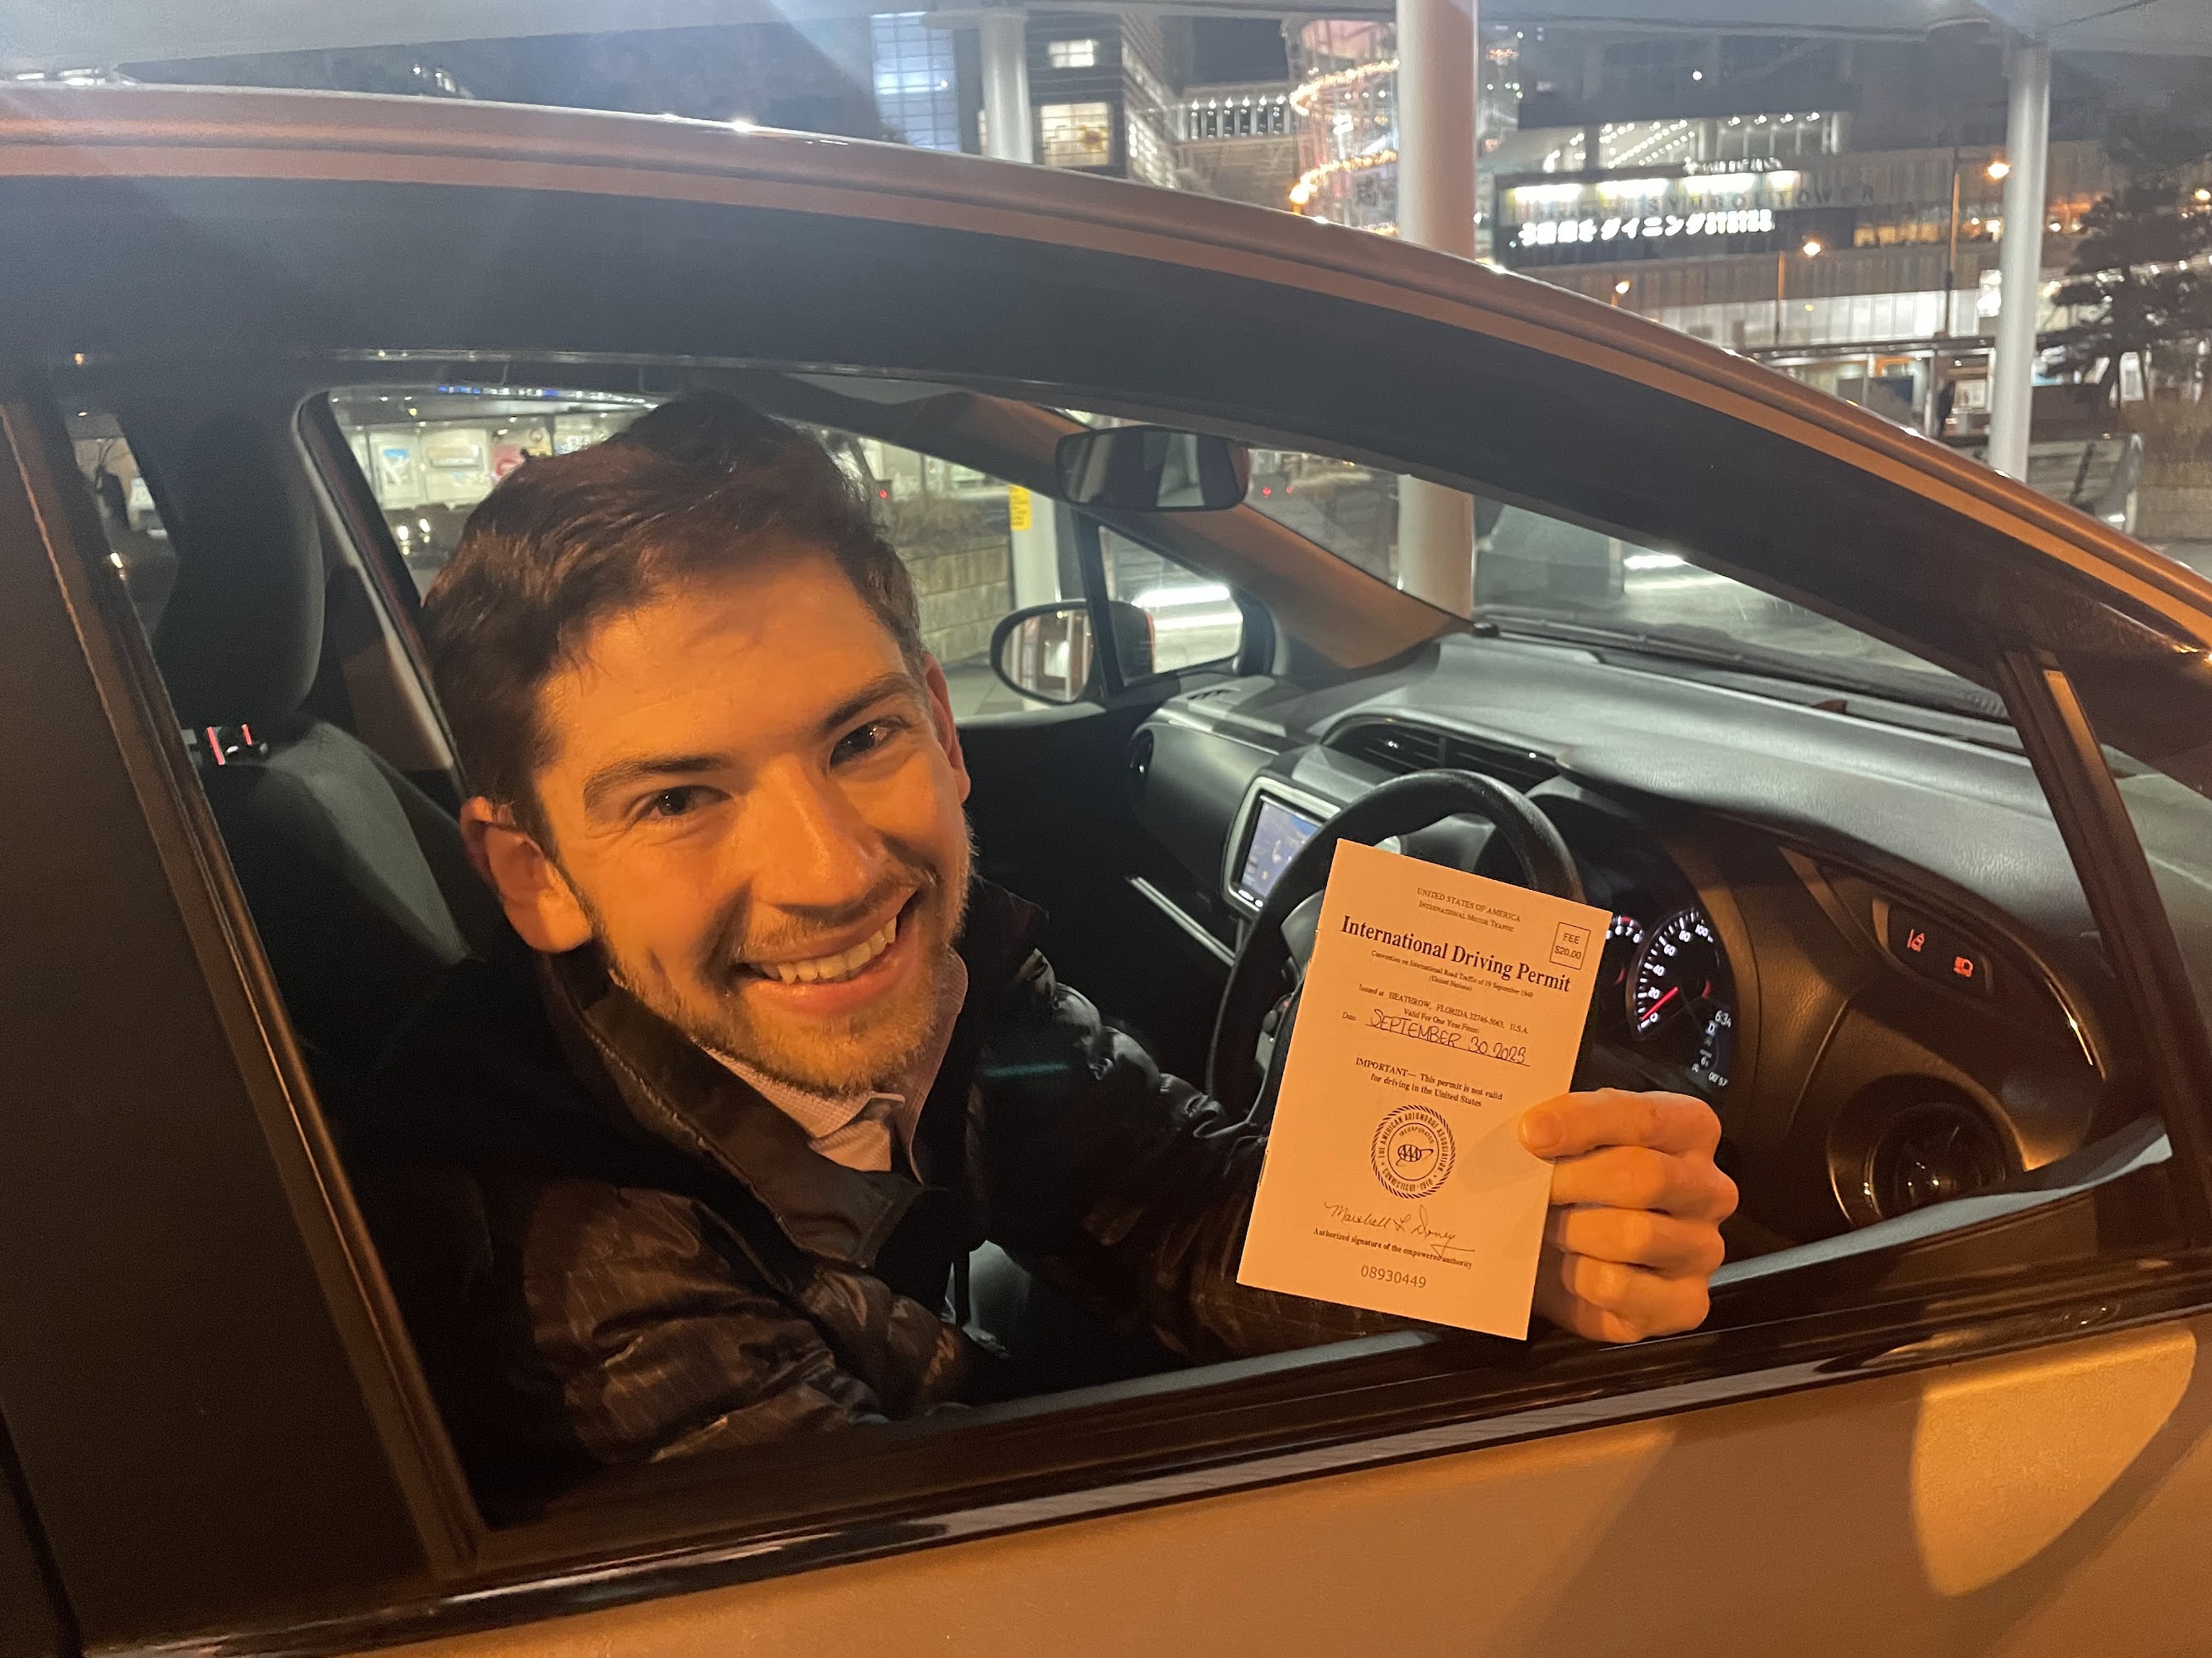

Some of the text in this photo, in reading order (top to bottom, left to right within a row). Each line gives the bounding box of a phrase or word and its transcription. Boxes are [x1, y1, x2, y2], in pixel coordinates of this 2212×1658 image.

[1417, 887, 1521, 922] UNITED STATES OF AMERICA
[1562, 932, 1580, 944] FEE
[1342, 916, 1570, 992] International Driving Permit
[1554, 945, 1582, 959] $20.00
[1371, 949, 1401, 964] Convention
[1410, 959, 1444, 974] International
[1443, 968, 1458, 978] Road
[1459, 973, 1477, 983] Traffic
[1493, 982, 1520, 995] September
[1429, 975, 1450, 985] (United
[1653, 964, 1665, 976] 40
[1358, 983, 1378, 995] Issued
[1388, 992, 1431, 1010] HEATHROW,
[1436, 1004, 1468, 1019] FLORIDA
[1648, 987, 1660, 999] 20
[1342, 1011, 1357, 1021] Date
[1404, 1007, 1421, 1019] Valid
[1421, 1012, 1432, 1021] For
[1432, 1016, 1445, 1025] One
[1447, 1019, 1461, 1030] Year
[1369, 1009, 1462, 1045] SEPTEMBER
[1469, 1036, 1488, 1055] 30
[1370, 1073, 1482, 1107] for driving in the United States
[1420, 1073, 1435, 1084] This
[1436, 1079, 1462, 1090] permit
[1463, 1084, 1469, 1093] is
[1470, 1088, 1483, 1096] not
[1485, 1091, 1503, 1100] valid
[1398, 1144, 1421, 1162] AAA
[1313, 1228, 1472, 1270] Authorized signature of the empowered authority
[1361, 1265, 1426, 1288] 08930449
